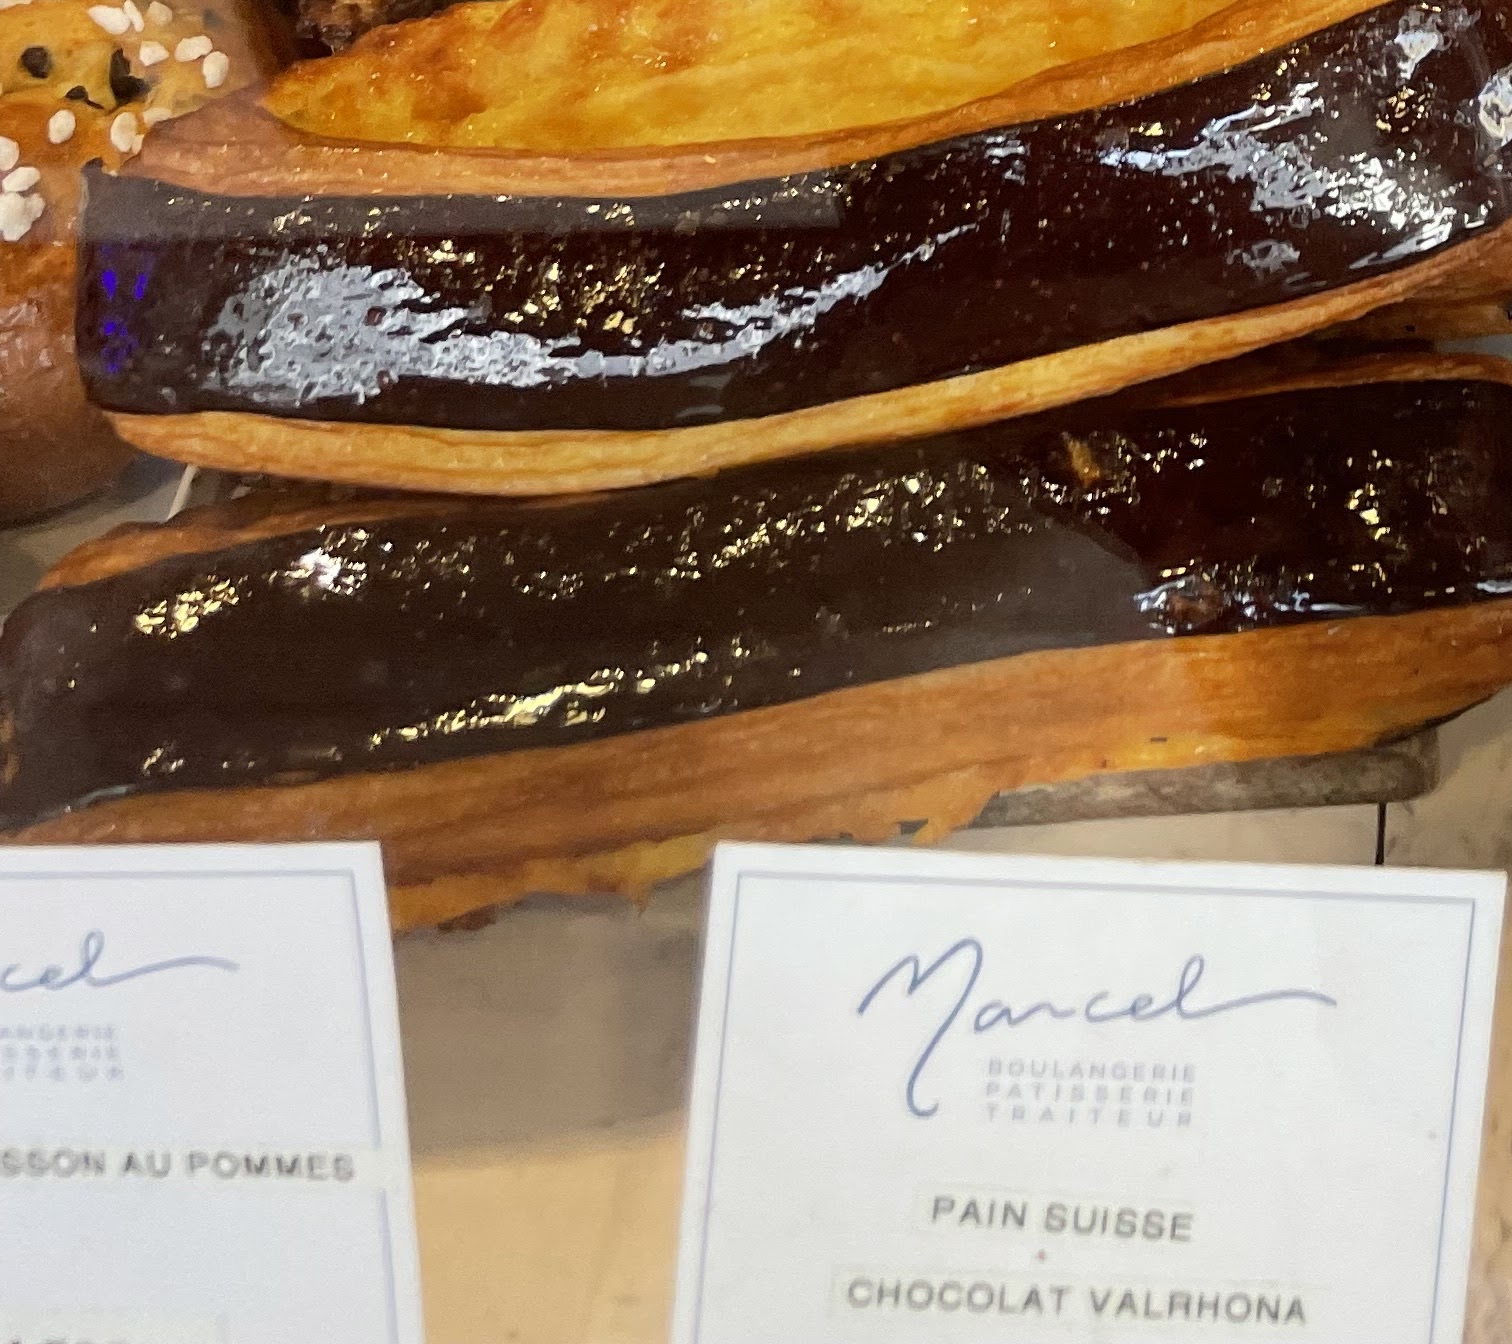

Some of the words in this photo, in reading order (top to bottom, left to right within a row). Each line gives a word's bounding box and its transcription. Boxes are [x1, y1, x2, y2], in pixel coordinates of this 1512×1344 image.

[857, 938, 1338, 1119] Marcel
[987, 1056, 1197, 1083] BOULANGERIE
[985, 1102, 1193, 1128] TRAITEUR
[119, 1149, 173, 1179] AU
[186, 1149, 355, 1182] POMMES
[931, 1194, 1029, 1230] PAIN
[1043, 1201, 1195, 1244] SUISSE
[846, 1276, 1074, 1314] CHOCOLAT
[1089, 1285, 1308, 1327] VALRHONA
